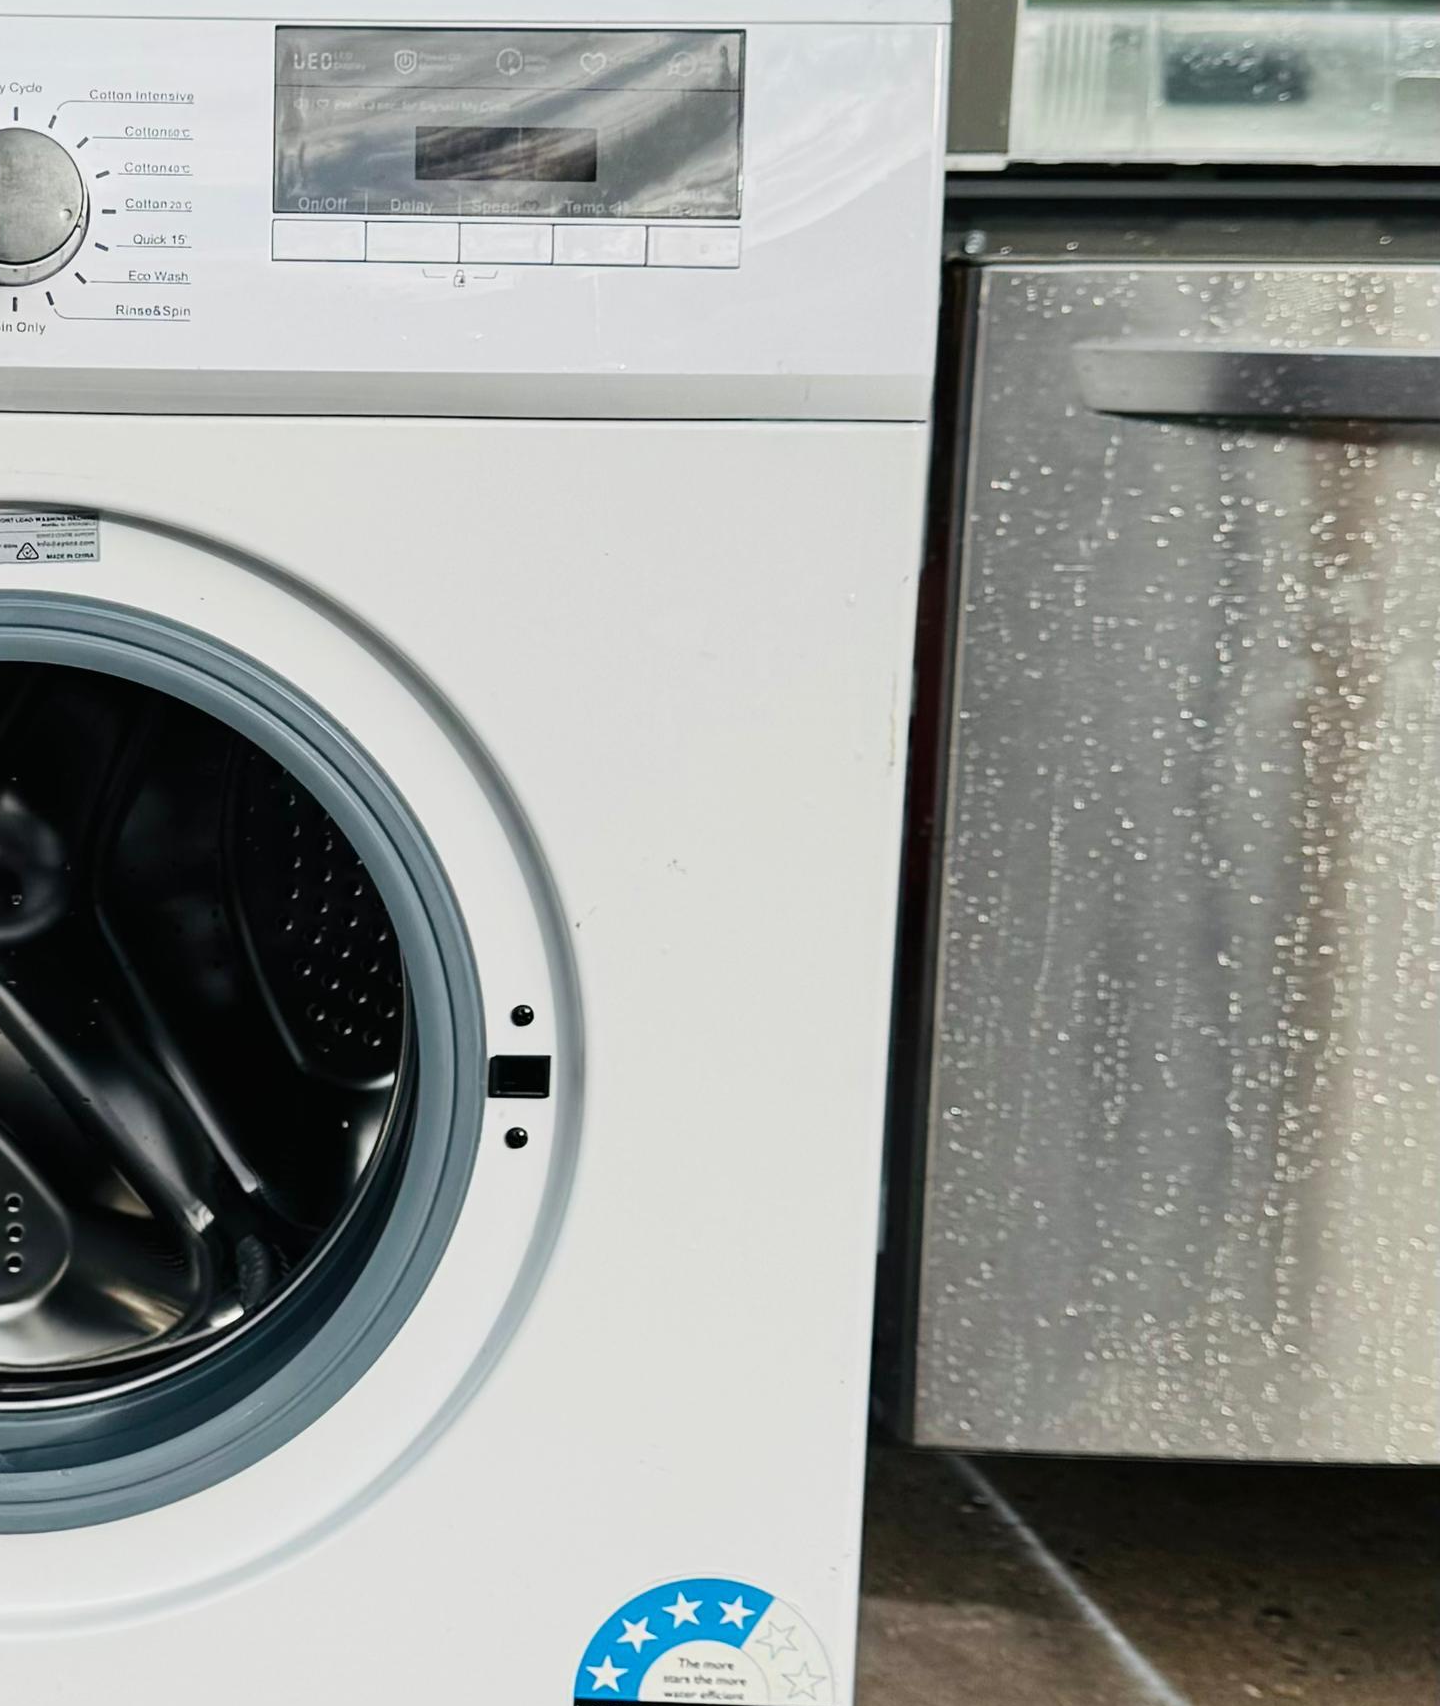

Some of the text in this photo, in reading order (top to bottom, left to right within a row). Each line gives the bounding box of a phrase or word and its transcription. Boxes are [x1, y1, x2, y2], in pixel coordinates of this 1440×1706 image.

[9, 81, 43, 95] Cycle
[89, 89, 194, 102] Cotton Intensive
[298, 196, 348, 211] On/Off
[390, 198, 434, 213] Delay
[133, 233, 167, 245] Quick
[128, 270, 189, 282] Eco Wash
[16, 321, 47, 336] Only
[678, 1657, 734, 1671] The more
[694, 1673, 713, 1685] the
[716, 1677, 747, 1687] more
